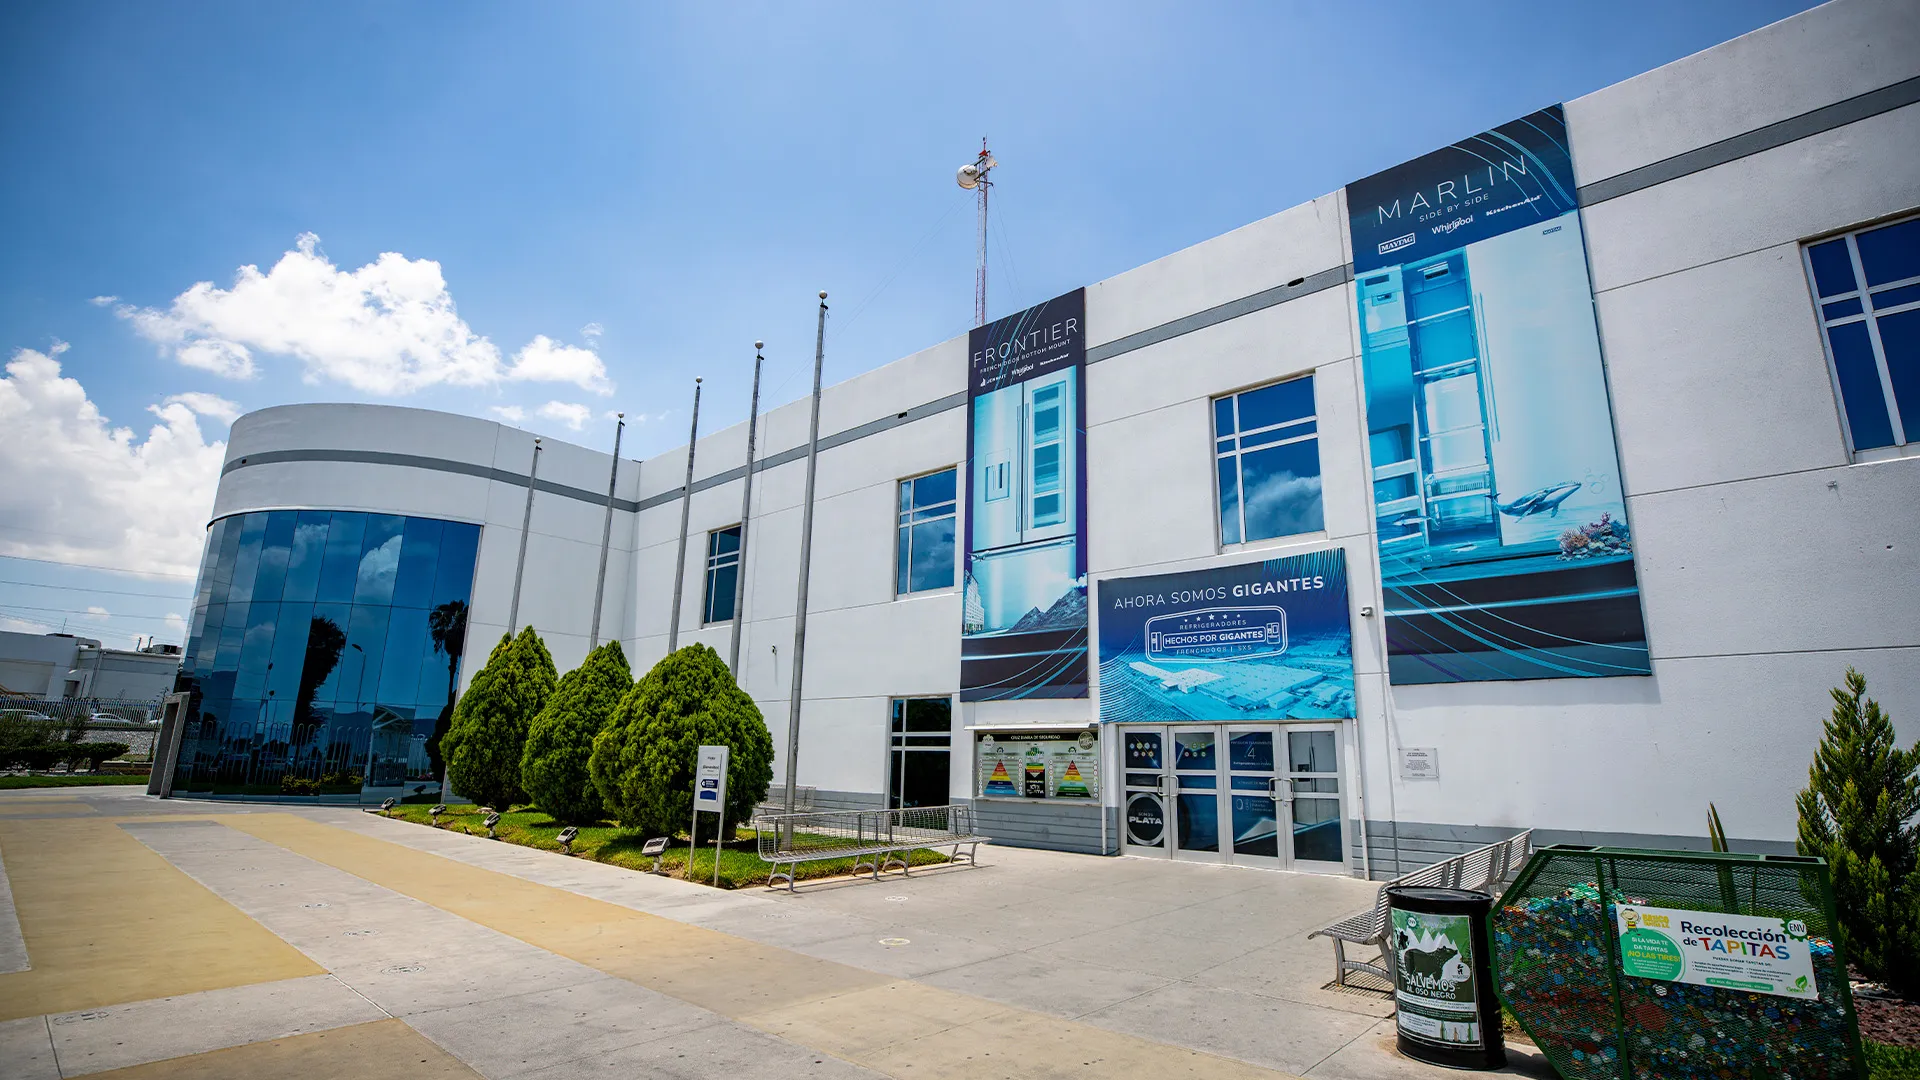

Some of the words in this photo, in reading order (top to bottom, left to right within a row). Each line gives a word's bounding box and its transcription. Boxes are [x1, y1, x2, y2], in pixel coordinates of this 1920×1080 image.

[1378, 154, 1528, 224] MARLIN
[1419, 209, 1442, 222] SIDE
[1446, 203, 1460, 213] BY
[1464, 193, 1490, 207] SIDE
[1431, 214, 1474, 235] Whirlpool
[1380, 236, 1414, 253] MAYTAG
[973, 317, 1078, 368] FRONTIER
[1021, 348, 1047, 360] BOTTOM
[1048, 339, 1071, 351] MOUNT
[1114, 594, 1166, 609] AHORA
[1171, 586, 1227, 604] SOMOS
[1232, 575, 1325, 598] GIGANTES
[1179, 619, 1247, 630] REFRIGERADORES
[1165, 635, 1198, 645] HECHOS
[1200, 634, 1217, 642] POR
[1219, 630, 1264, 640] GIGANTES
[1129, 816, 1162, 825] PLATA
[1681, 921, 1786, 943] Recolección
[1789, 923, 1805, 933] ENV
[1658, 954, 1680, 962] TIRES!
[1683, 937, 1698, 946] de
[1698, 937, 1790, 960] TAPITAS
[1406, 975, 1456, 992] SALVEMOS
[1406, 985, 1414, 993] AL
[1415, 988, 1429, 996] OSO
[1430, 991, 1456, 1000] NEGRO
